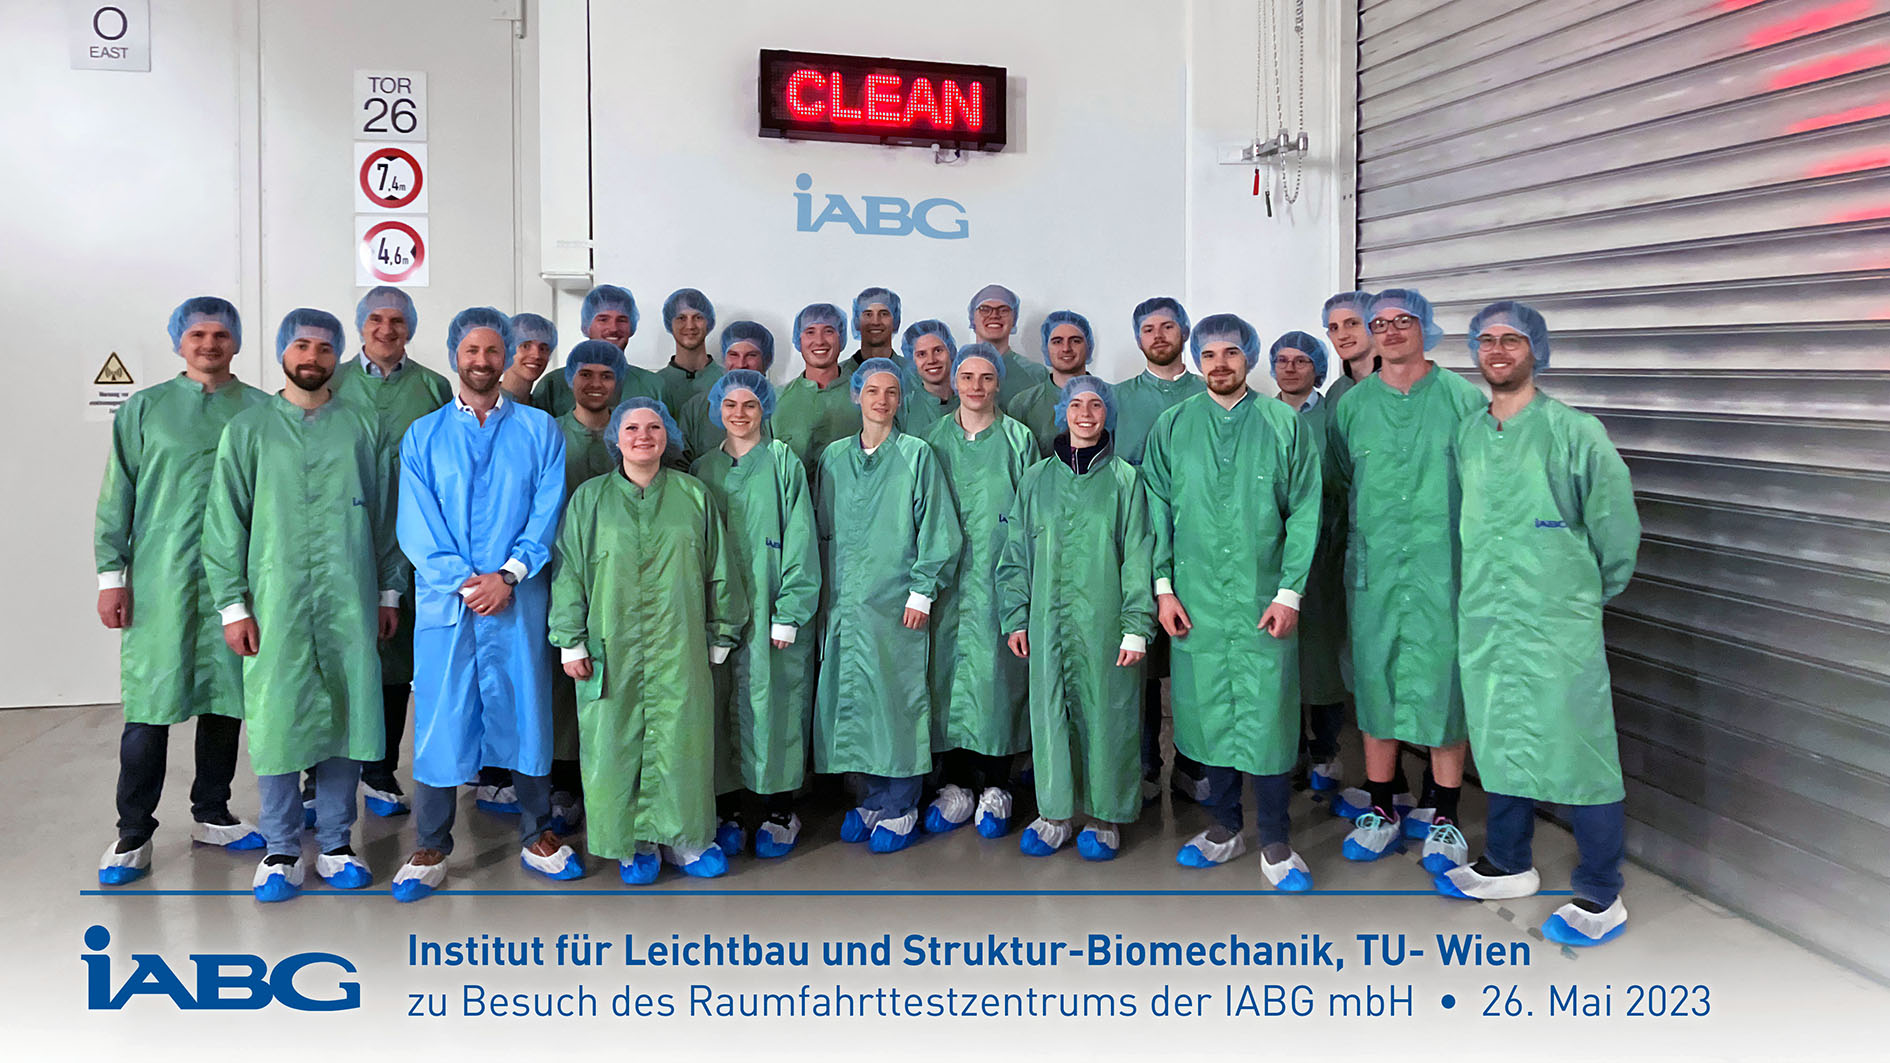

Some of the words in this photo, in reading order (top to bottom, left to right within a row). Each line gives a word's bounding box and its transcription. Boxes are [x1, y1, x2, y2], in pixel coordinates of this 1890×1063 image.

[93, 6, 128, 41] O
[89, 46, 128, 59] EAST
[367, 77, 412, 94] TOR
[788, 69, 981, 127] CLEAN
[363, 97, 417, 133] 26
